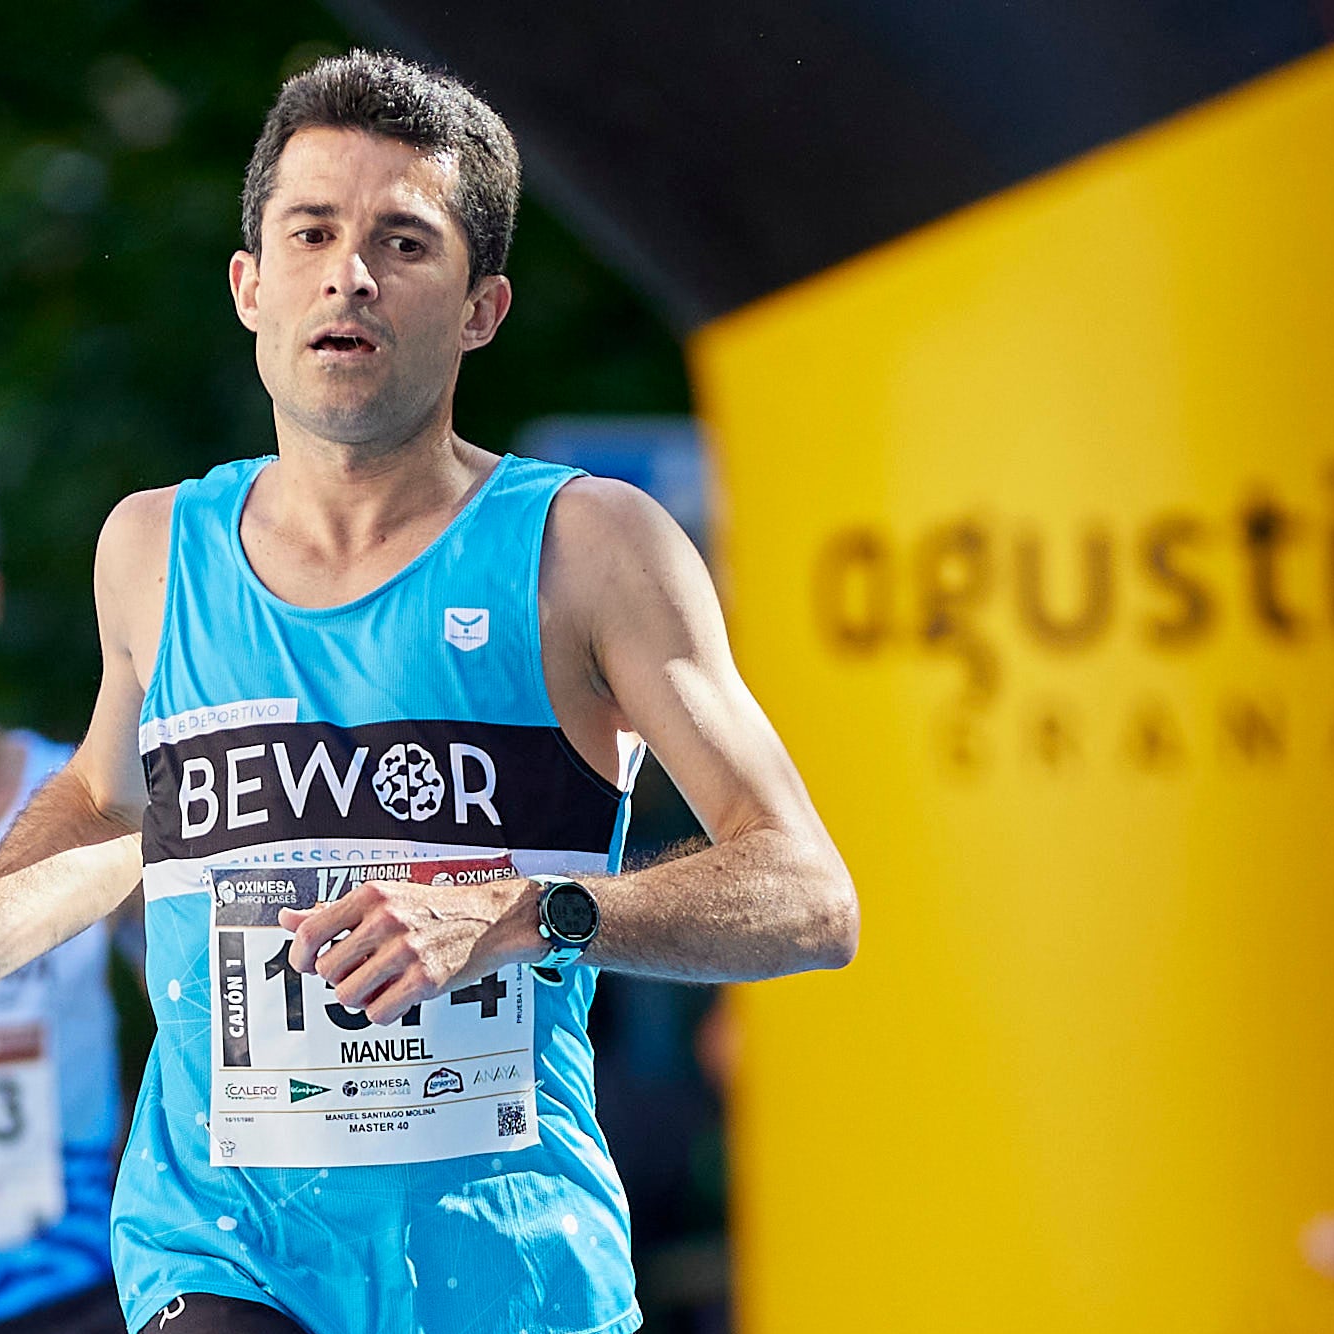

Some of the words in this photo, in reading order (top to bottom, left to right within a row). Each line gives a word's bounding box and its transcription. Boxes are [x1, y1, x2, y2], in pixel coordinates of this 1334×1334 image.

[235, 880, 297, 894] OXIMESA
[317, 867, 349, 902] 17
[349, 864, 412, 882] MEMORIAL
[237, 895, 266, 904] NIPPON
[267, 894, 297, 905] GASES
[226, 959, 242, 968] 1
[223, 976, 245, 1038] CAJÓN
[341, 1037, 434, 1064] MANUEL
[473, 1065, 521, 1085] ANAYA
[229, 1086, 278, 1096] CALERO
[360, 1079, 411, 1089] OXIMESA
[325, 1112, 359, 1121] MANUEL
[361, 1110, 404, 1120] SANTIAGO
[405, 1107, 436, 1117] MOLINA
[349, 1122, 394, 1133] MASTER
[397, 1121, 409, 1130] 40
